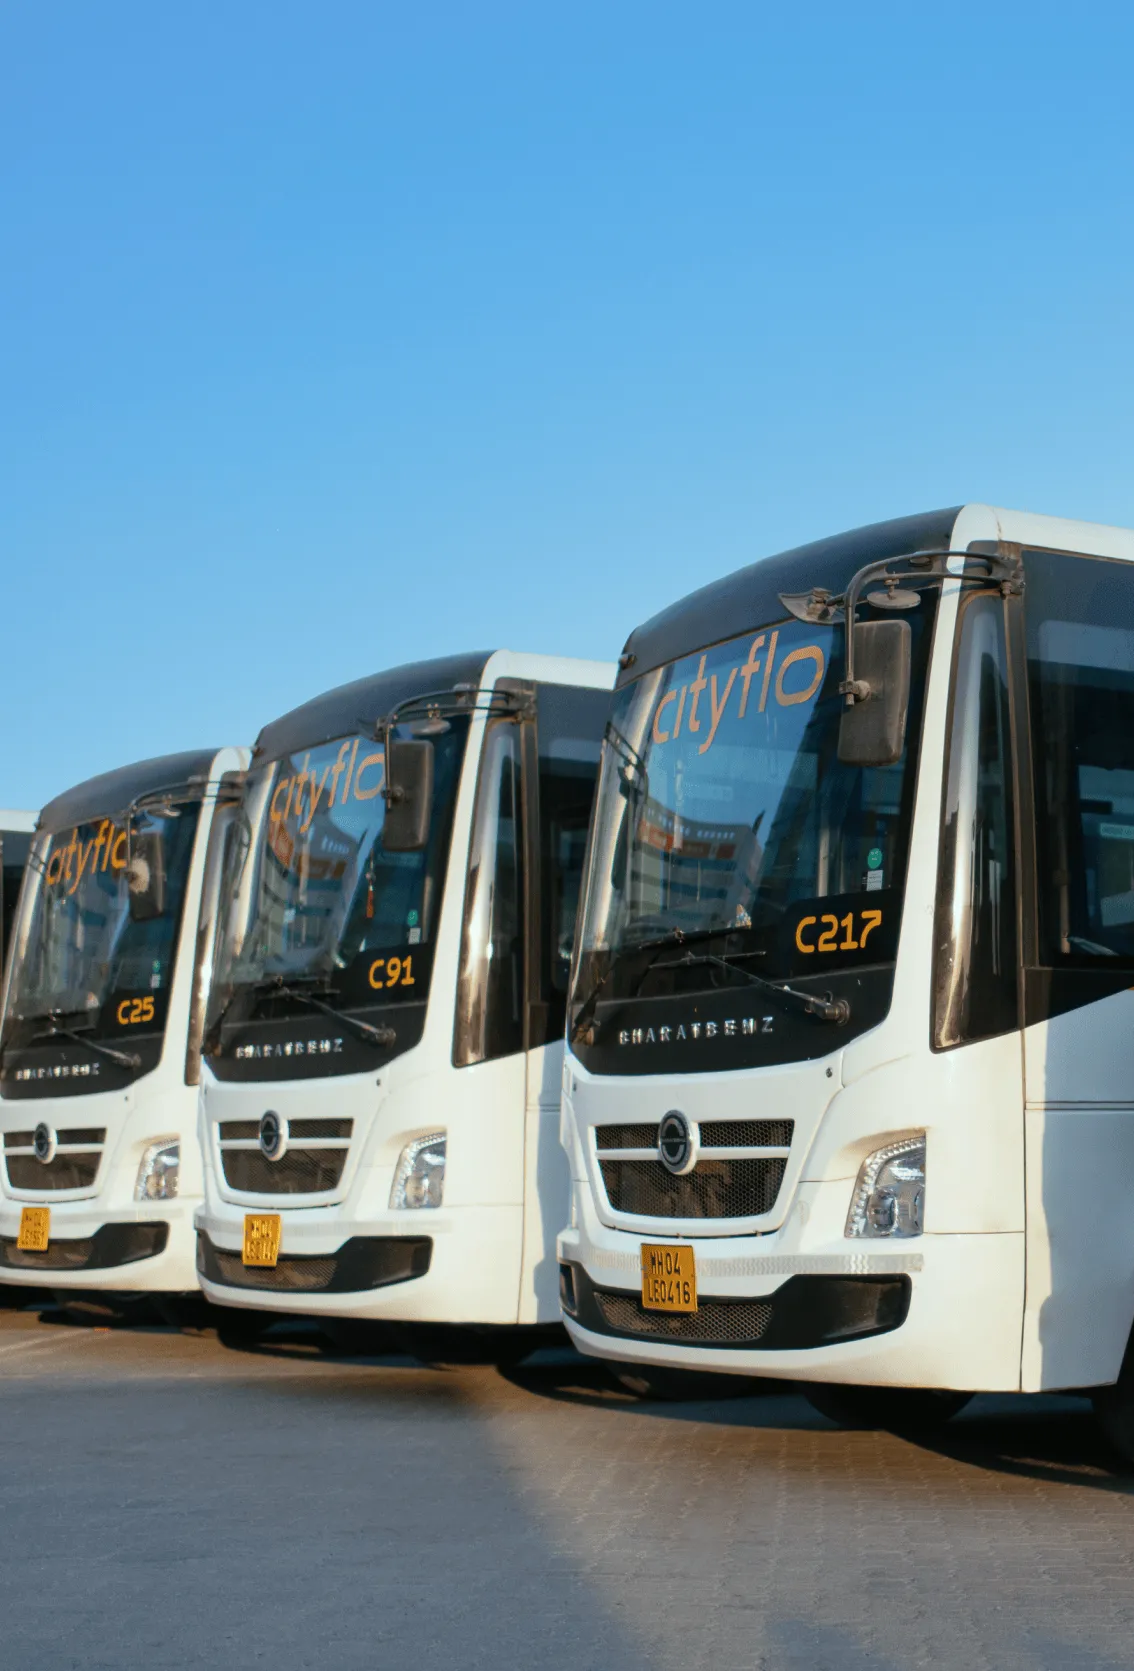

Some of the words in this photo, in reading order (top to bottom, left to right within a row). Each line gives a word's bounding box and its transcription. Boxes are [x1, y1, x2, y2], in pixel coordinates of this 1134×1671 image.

[652, 630, 825, 755] cityflo
[270, 738, 386, 833] cityflo
[795, 909, 882, 953] C217
[368, 954, 415, 989] C91
[117, 995, 155, 1025] C25
[618, 1016, 774, 1045] BHARATBENZ
[650, 1249, 681, 1276] MH04
[647, 1278, 691, 1305] LE0416
